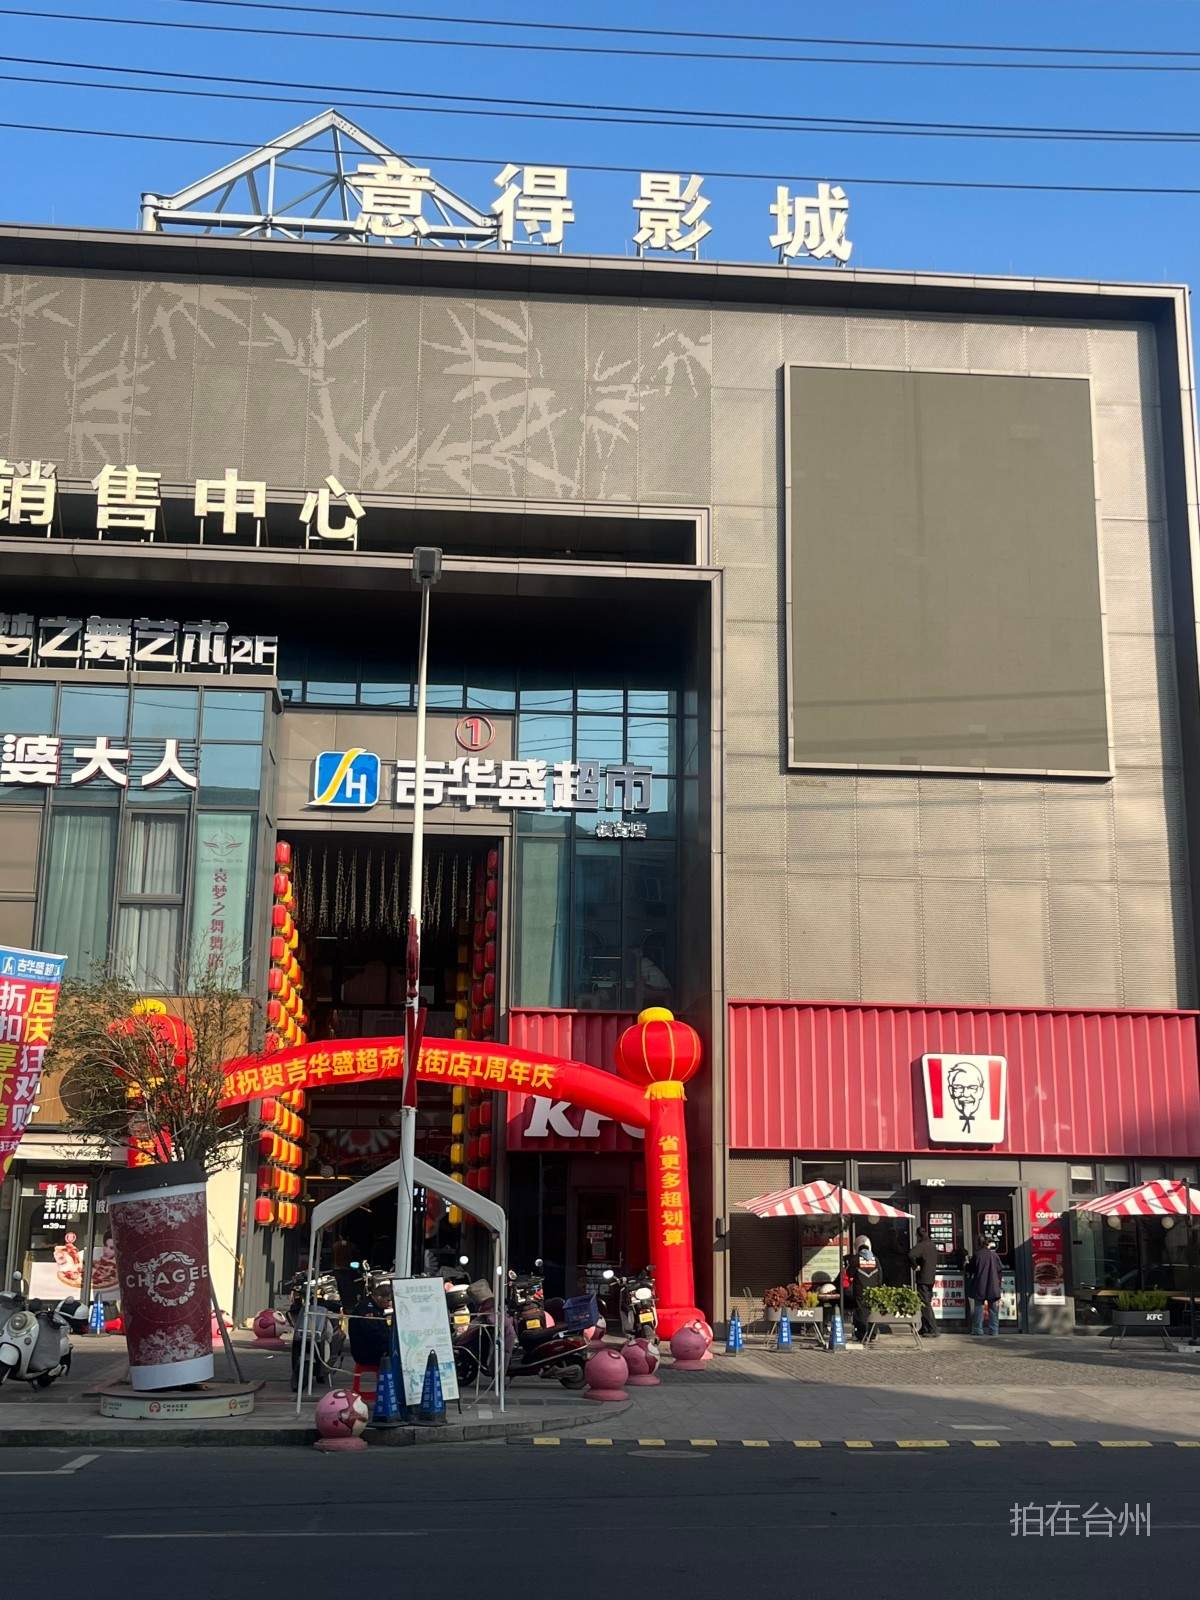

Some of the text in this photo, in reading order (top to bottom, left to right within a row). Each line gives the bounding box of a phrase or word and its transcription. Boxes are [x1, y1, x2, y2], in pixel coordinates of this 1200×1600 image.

[350, 158, 853, 262] 意得影城
[0, 459, 366, 539] 销售中心
[0, 734, 198, 790] 婆大人
[396, 757, 653, 813] 吉华盛超市
[658, 1135, 685, 1247] 省更多超划算
[926, 1178, 946, 1187] KFC
[1028, 1188, 1057, 1224] K
[125, 1264, 209, 1288] CHAGEE
[796, 1309, 815, 1318] KFC
[1146, 1313, 1164, 1321] KFC
